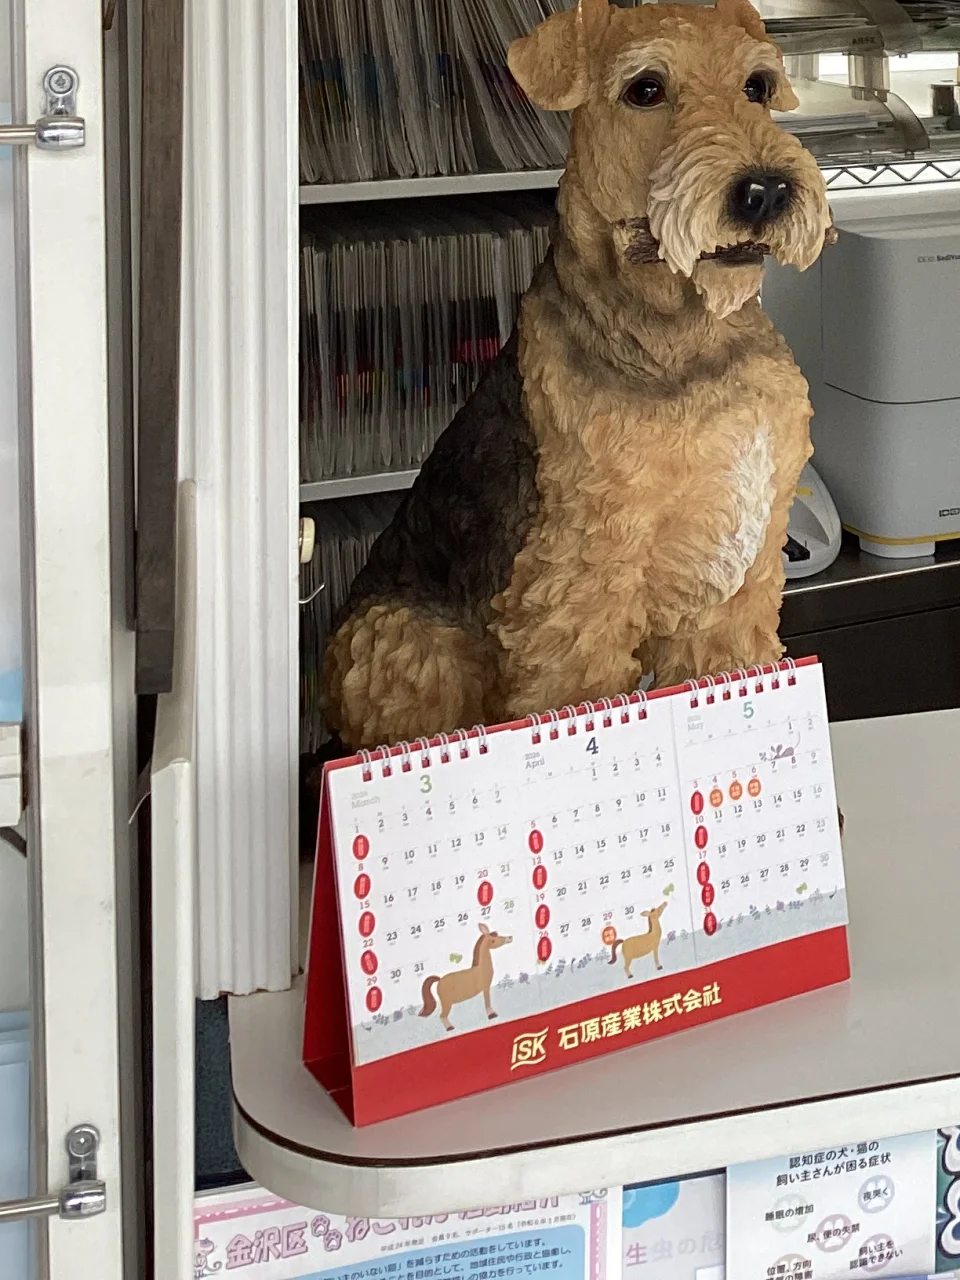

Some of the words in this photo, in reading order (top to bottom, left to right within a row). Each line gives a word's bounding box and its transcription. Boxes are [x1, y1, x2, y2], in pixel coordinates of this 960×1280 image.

[743, 701, 754, 719] 5
[585, 736, 599, 755] 4
[525, 757, 545, 770] April
[419, 774, 433, 794] 3
[636, 793, 645, 802] 10
[657, 788, 666, 797] 11
[715, 811, 722, 819] 11
[734, 805, 742, 813] 12
[754, 800, 762, 808] 13
[774, 795, 782, 803] 14
[793, 790, 802, 798] 15
[813, 786, 822, 794] 16
[404, 850, 415, 860] 10
[428, 844, 437, 853] 11
[452, 838, 461, 848] 12
[475, 833, 485, 842] 13
[497, 827, 507, 836] 14
[533, 857, 542, 865] 12
[554, 851, 563, 860] 13
[575, 845, 585, 854] 14
[597, 840, 606, 849] 15
[618, 834, 628, 844] 16
[640, 829, 648, 838] 17
[661, 824, 670, 833] 18
[699, 851, 707, 859] 17
[718, 845, 727, 853] 18
[737, 840, 746, 848] 19
[756, 835, 766, 843] 20
[776, 830, 785, 838] 21
[796, 825, 805, 833] 22
[816, 819, 825, 828] 23
[360, 901, 370, 910] 15
[384, 894, 394, 904] 16
[408, 887, 418, 897] 17
[431, 882, 442, 891] 18
[455, 876, 465, 885] 19
[478, 870, 488, 879] 20
[501, 864, 510, 873] 21
[536, 893, 545, 902] 19
[556, 887, 567, 896] 20
[578, 882, 587, 891] 21
[600, 876, 609, 885] 22
[621, 870, 631, 879] 23
[643, 865, 652, 874] 24
[664, 859, 674, 869] 25
[721, 880, 730, 889] 25
[740, 875, 749, 883] 26
[760, 869, 769, 878] 27
[780, 864, 789, 873] 28
[800, 859, 809, 867] 29
[820, 854, 829, 862] 30
[363, 938, 373, 948] 22
[387, 932, 398, 941] 23
[411, 925, 422, 935] 24
[435, 919, 445, 928] 25
[458, 912, 468, 922] 26
[481, 906, 491, 916] 27
[504, 901, 515, 910] 28
[560, 924, 570, 933] 27
[581, 918, 591, 927] 28
[603, 912, 613, 920] 29
[625, 906, 635, 915] 30
[367, 977, 377, 986] 29
[391, 970, 401, 979] 30
[415, 963, 424, 972] 31
[511, 1031, 548, 1065] ISK
[557, 981, 723, 1051] 石原産業株式会社
[776, 1151, 892, 1187] 飼い主さんが困る症状
[765, 1204, 814, 1222] 睡眠の増加
[226, 1222, 308, 1269] 金沢区
